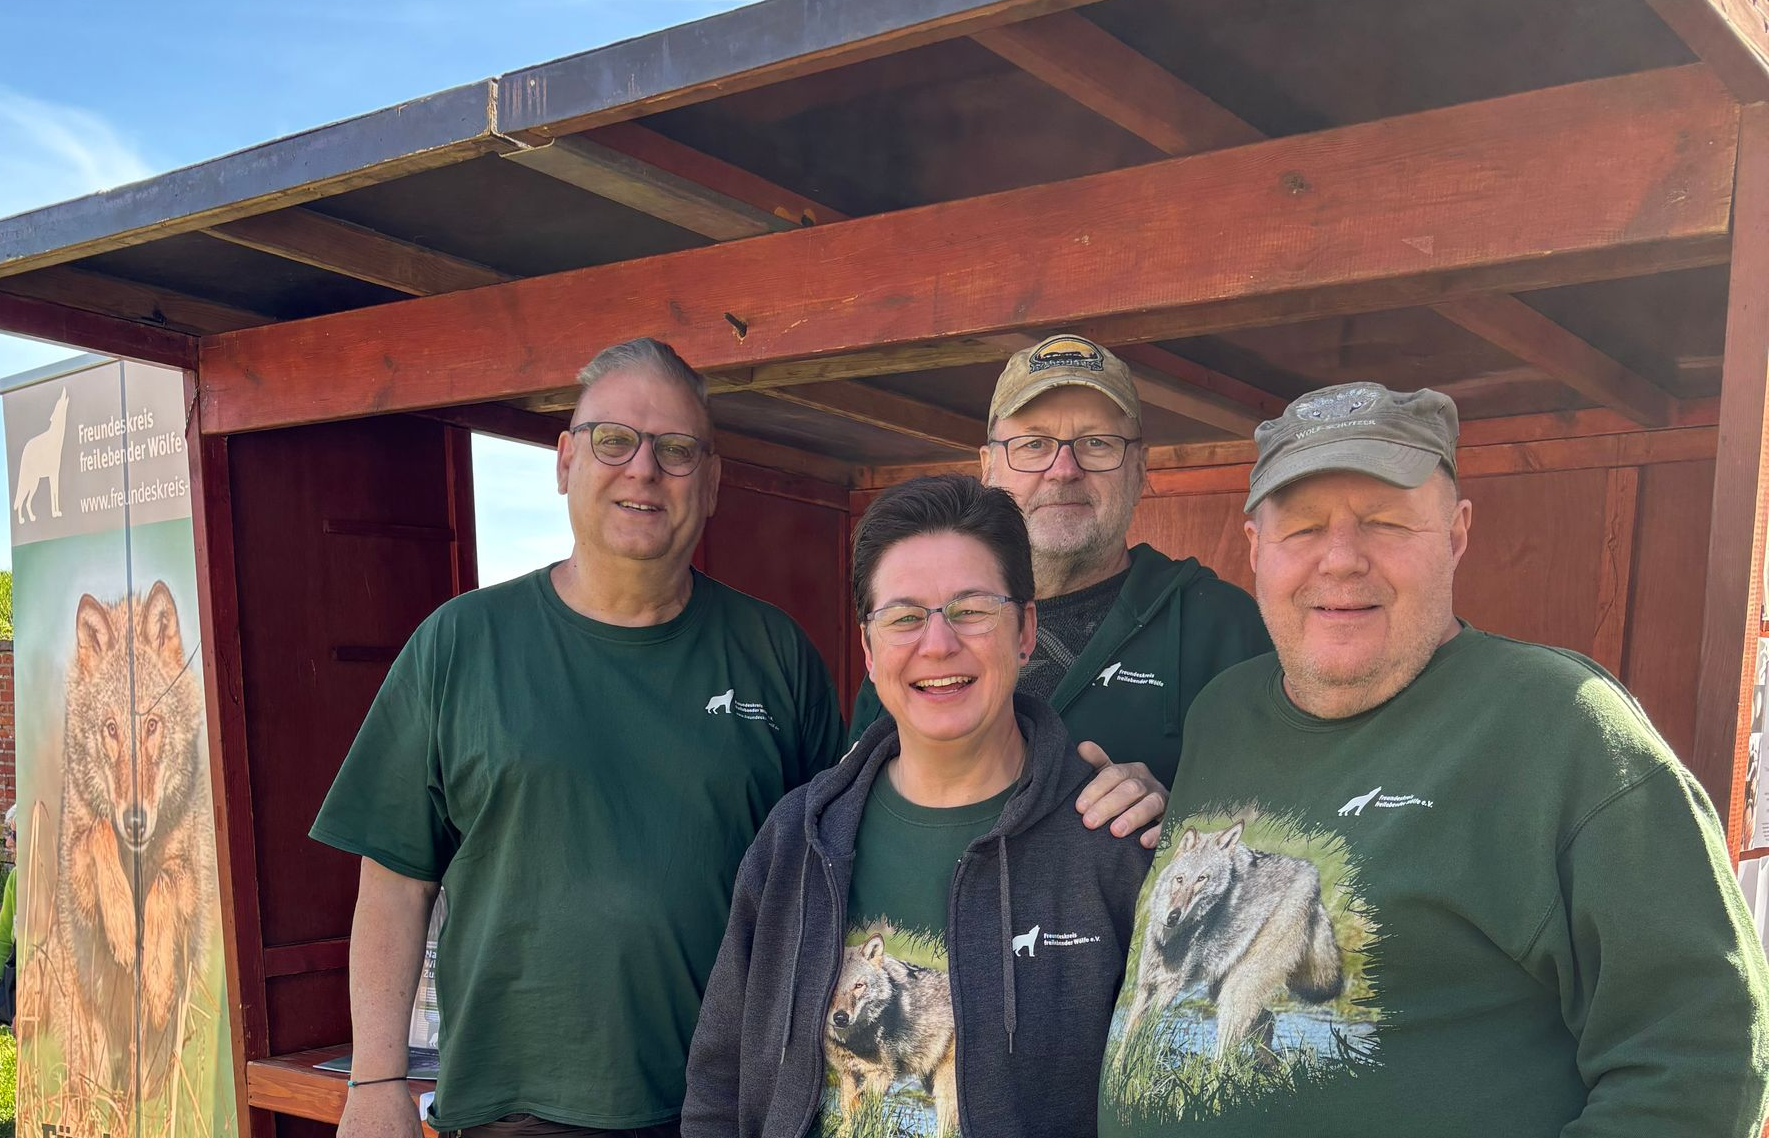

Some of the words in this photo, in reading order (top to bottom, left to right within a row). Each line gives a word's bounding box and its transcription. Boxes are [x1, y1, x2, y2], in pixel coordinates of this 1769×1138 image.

[78, 408, 154, 444] Freundeskreis
[80, 440, 146, 473] freilebender
[147, 431, 182, 458] Wölfe
